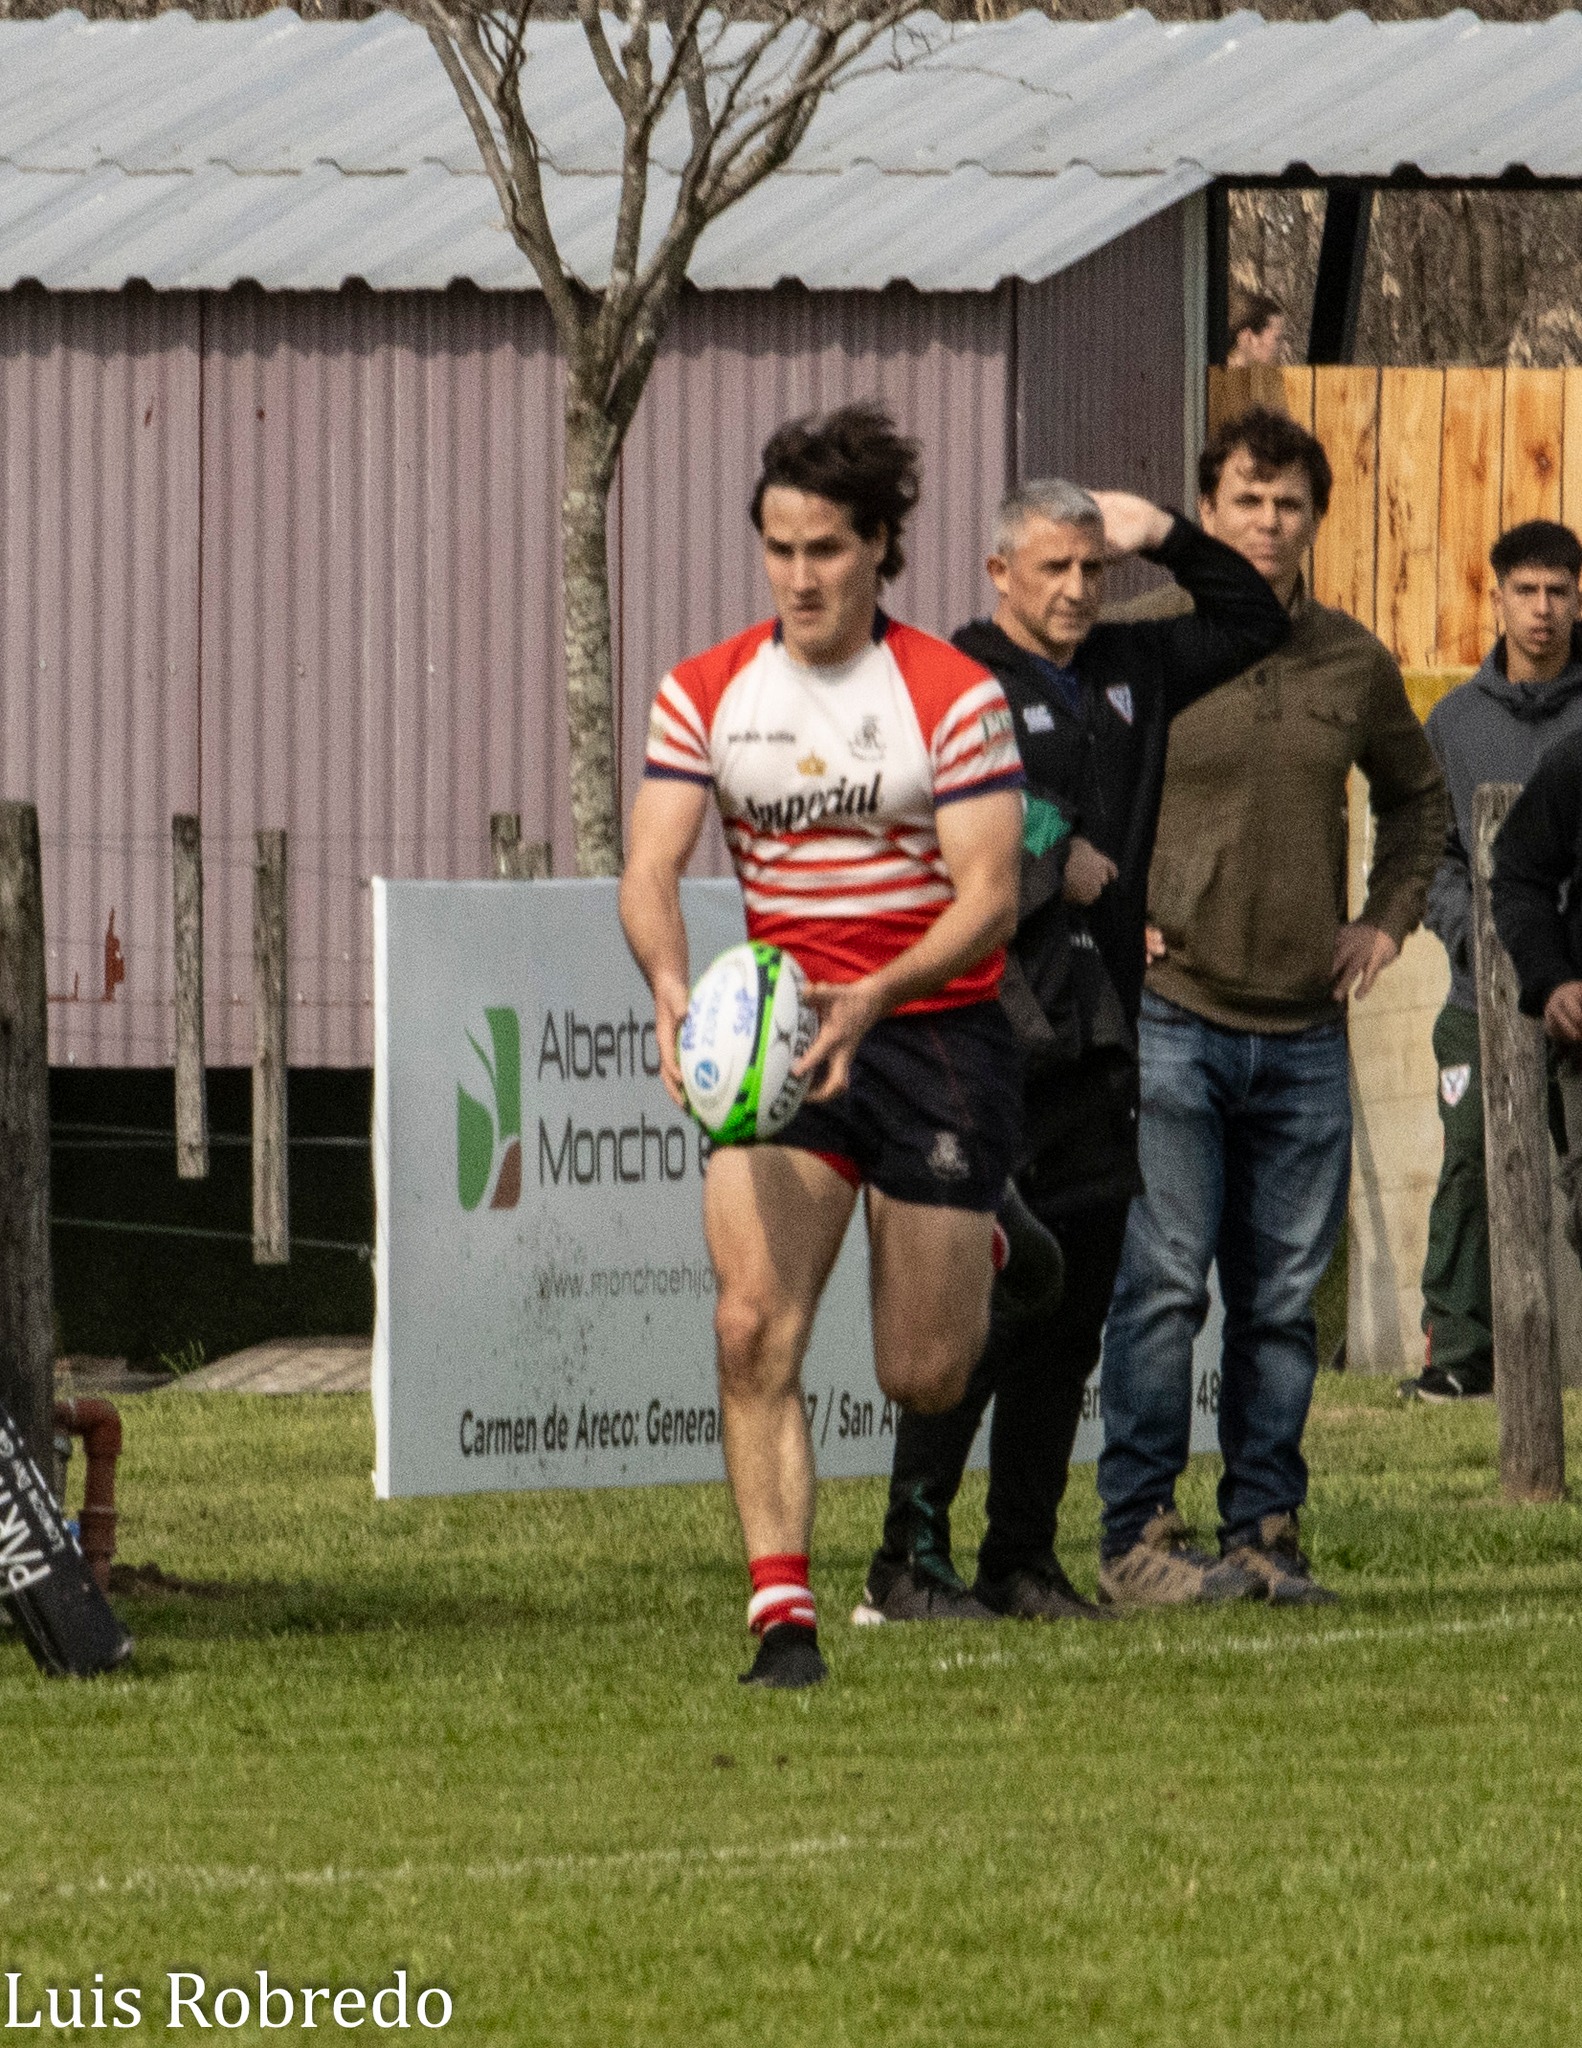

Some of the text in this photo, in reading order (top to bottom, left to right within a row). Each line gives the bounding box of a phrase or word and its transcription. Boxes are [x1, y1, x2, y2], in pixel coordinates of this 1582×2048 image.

[538, 1008, 660, 1082] Alberto
[538, 1112, 686, 1186] Moncho
[459, 1408, 537, 1457] Carmen
[543, 1402, 568, 1451] de
[574, 1401, 640, 1450] Areco:
[646, 1398, 724, 1446] General
[838, 1388, 873, 1439] San
